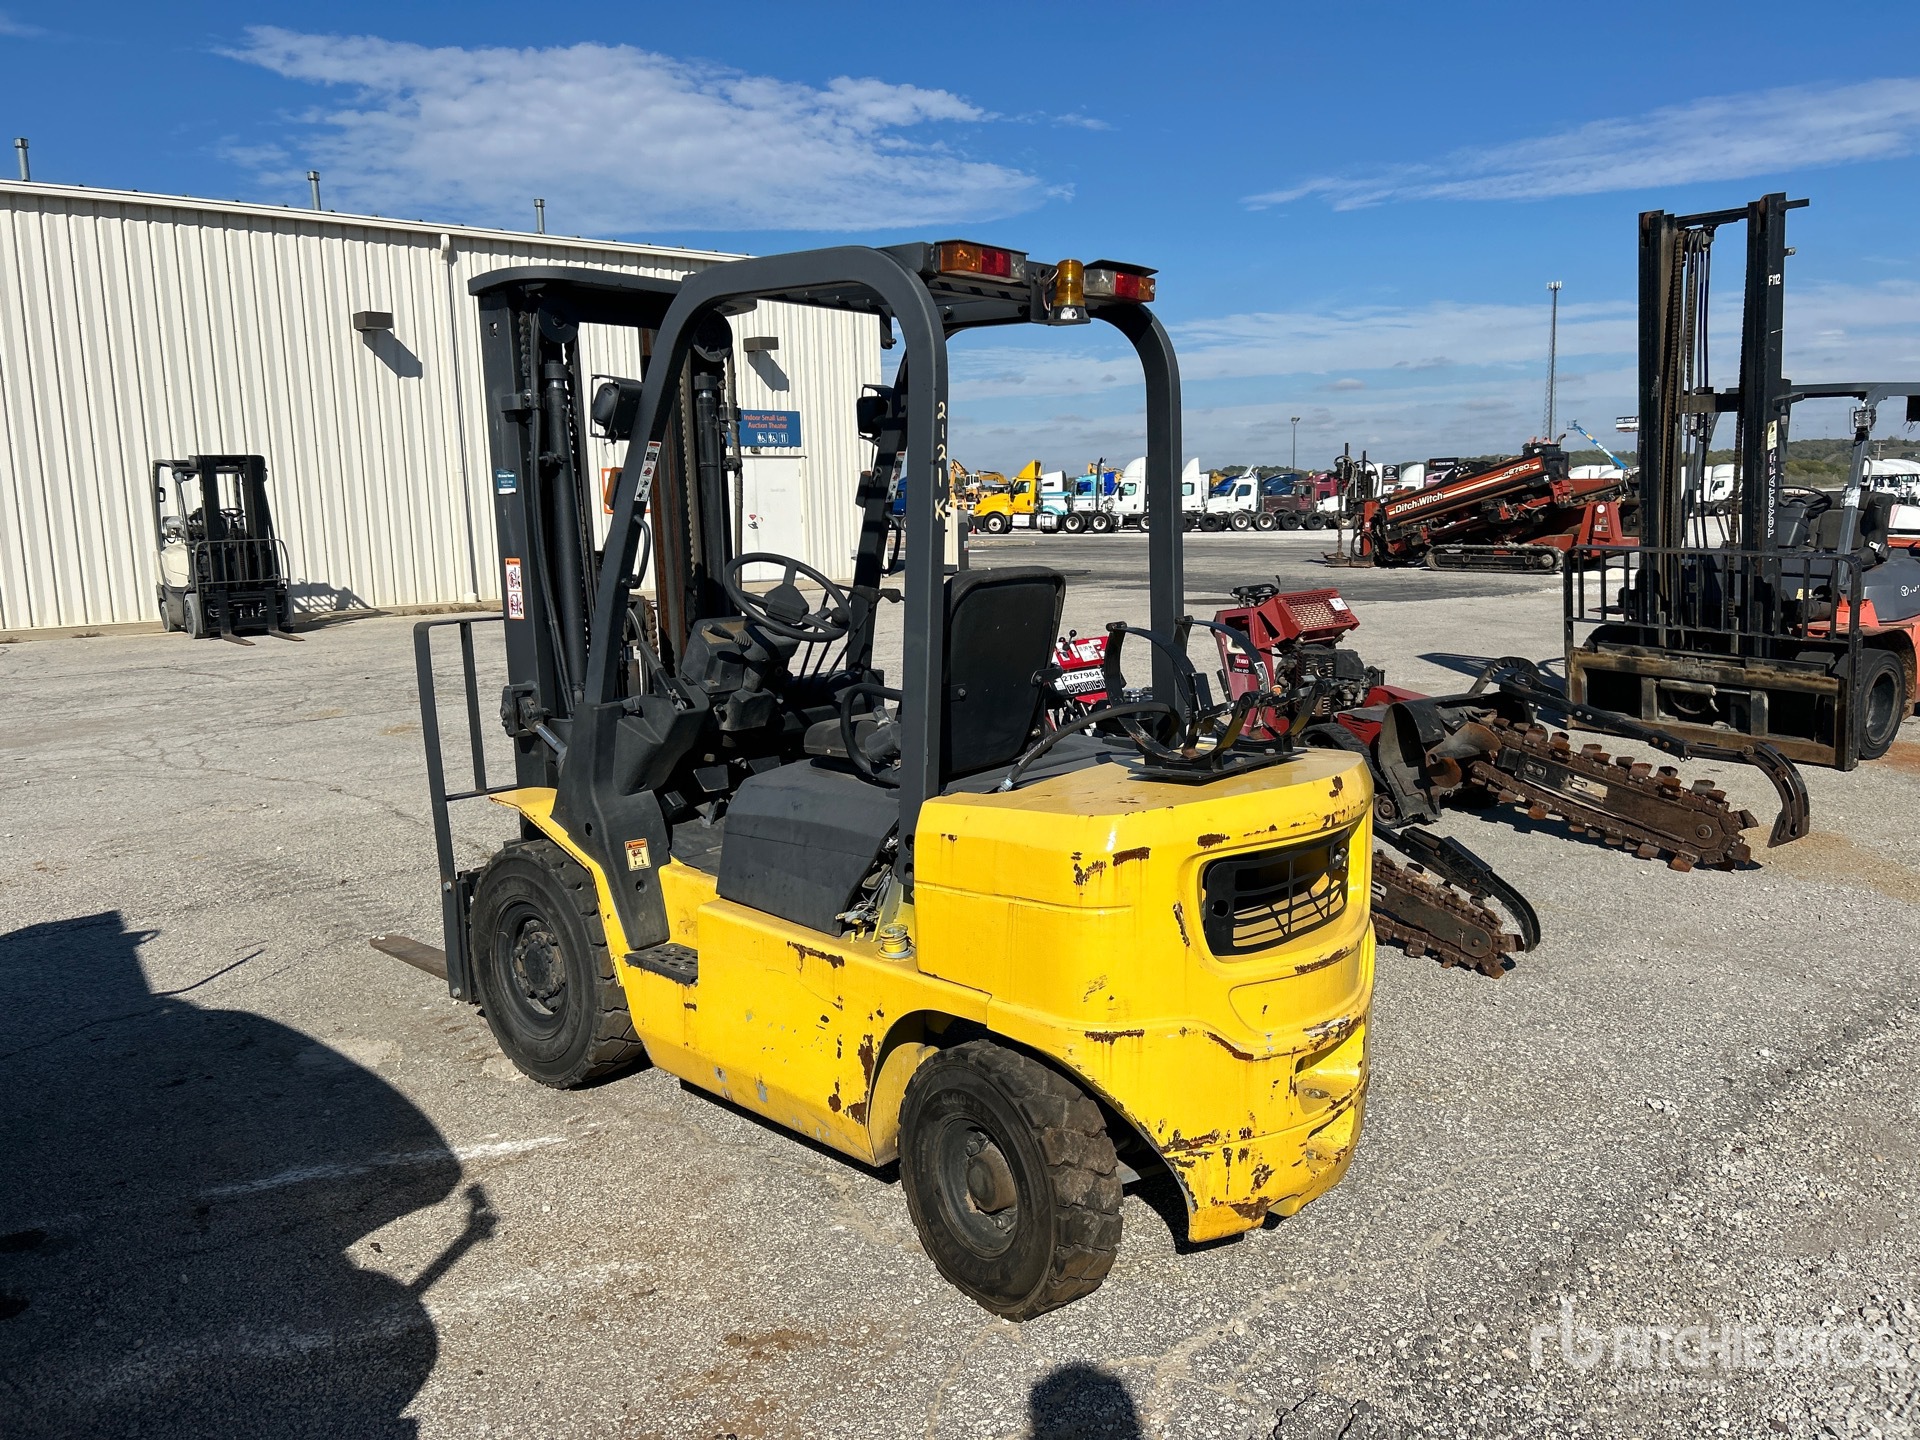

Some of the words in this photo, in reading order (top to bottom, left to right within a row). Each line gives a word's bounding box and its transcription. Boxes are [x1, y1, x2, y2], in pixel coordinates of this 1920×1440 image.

[1395, 499, 1418, 514] Ditch
[1418, 492, 1443, 507] Witch
[1767, 475, 1776, 538] TOYOTA
[1062, 670, 1100, 682] 2767964
